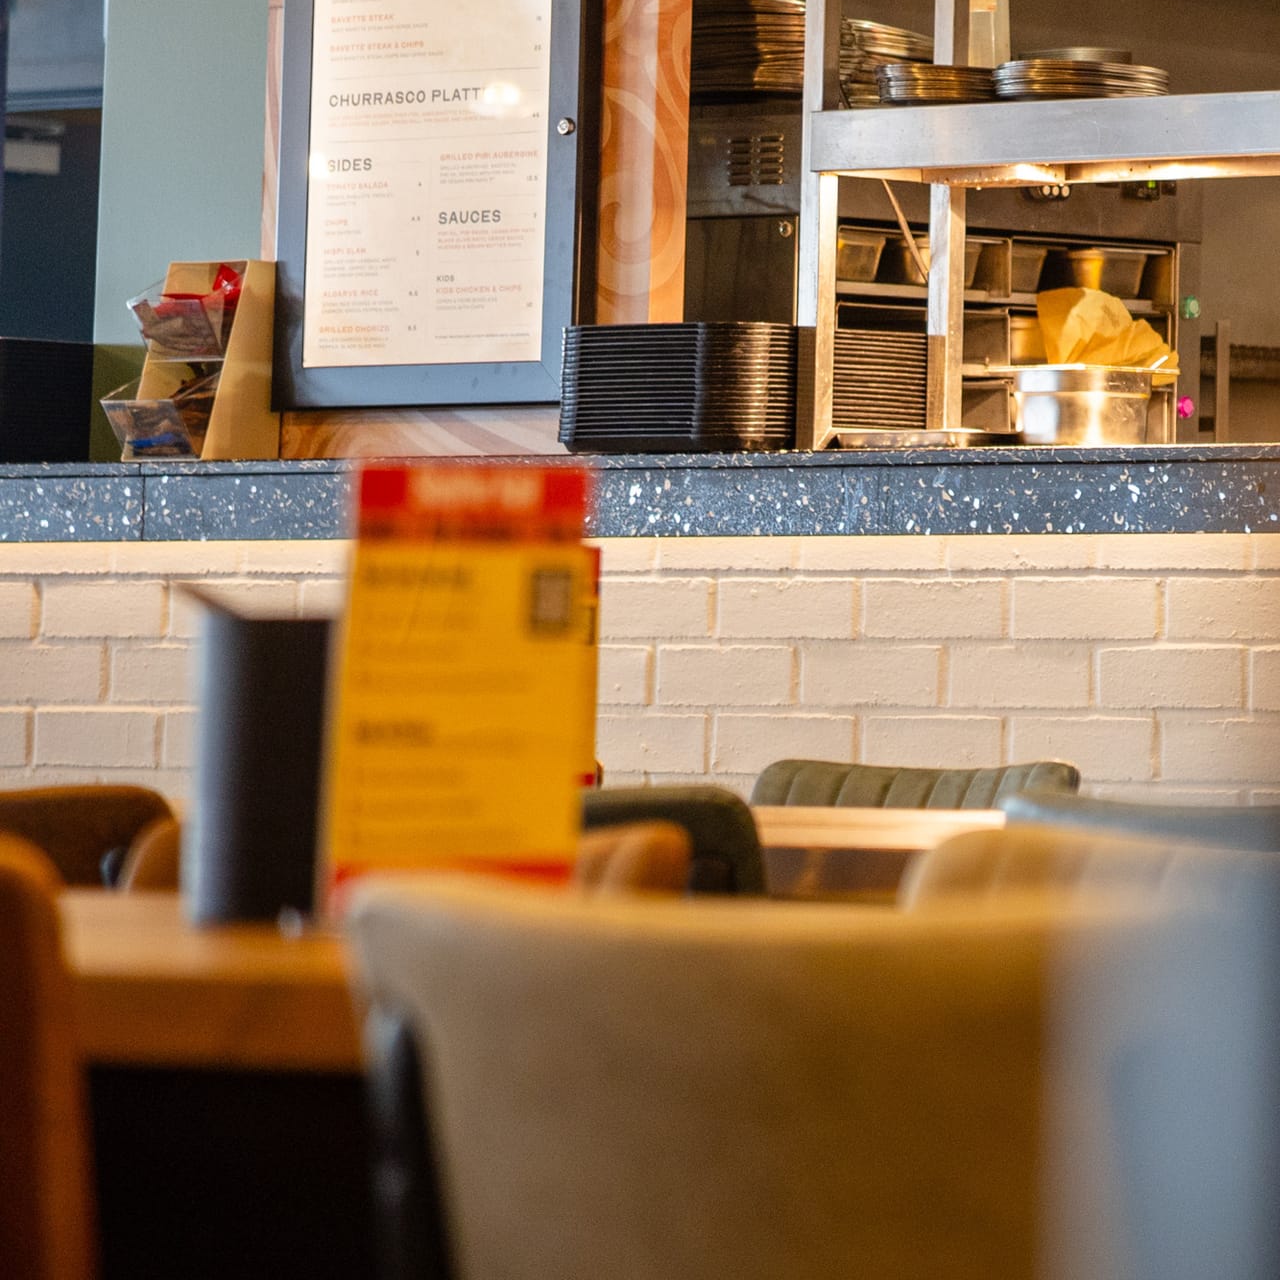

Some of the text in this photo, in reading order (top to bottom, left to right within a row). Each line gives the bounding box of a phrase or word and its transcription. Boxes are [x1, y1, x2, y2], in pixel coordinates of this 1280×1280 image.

[329, 90, 426, 108] CHURRASCO
[328, 158, 373, 172] SIDES
[438, 209, 501, 225] SAUCES
[436, 274, 455, 283] KIDS
